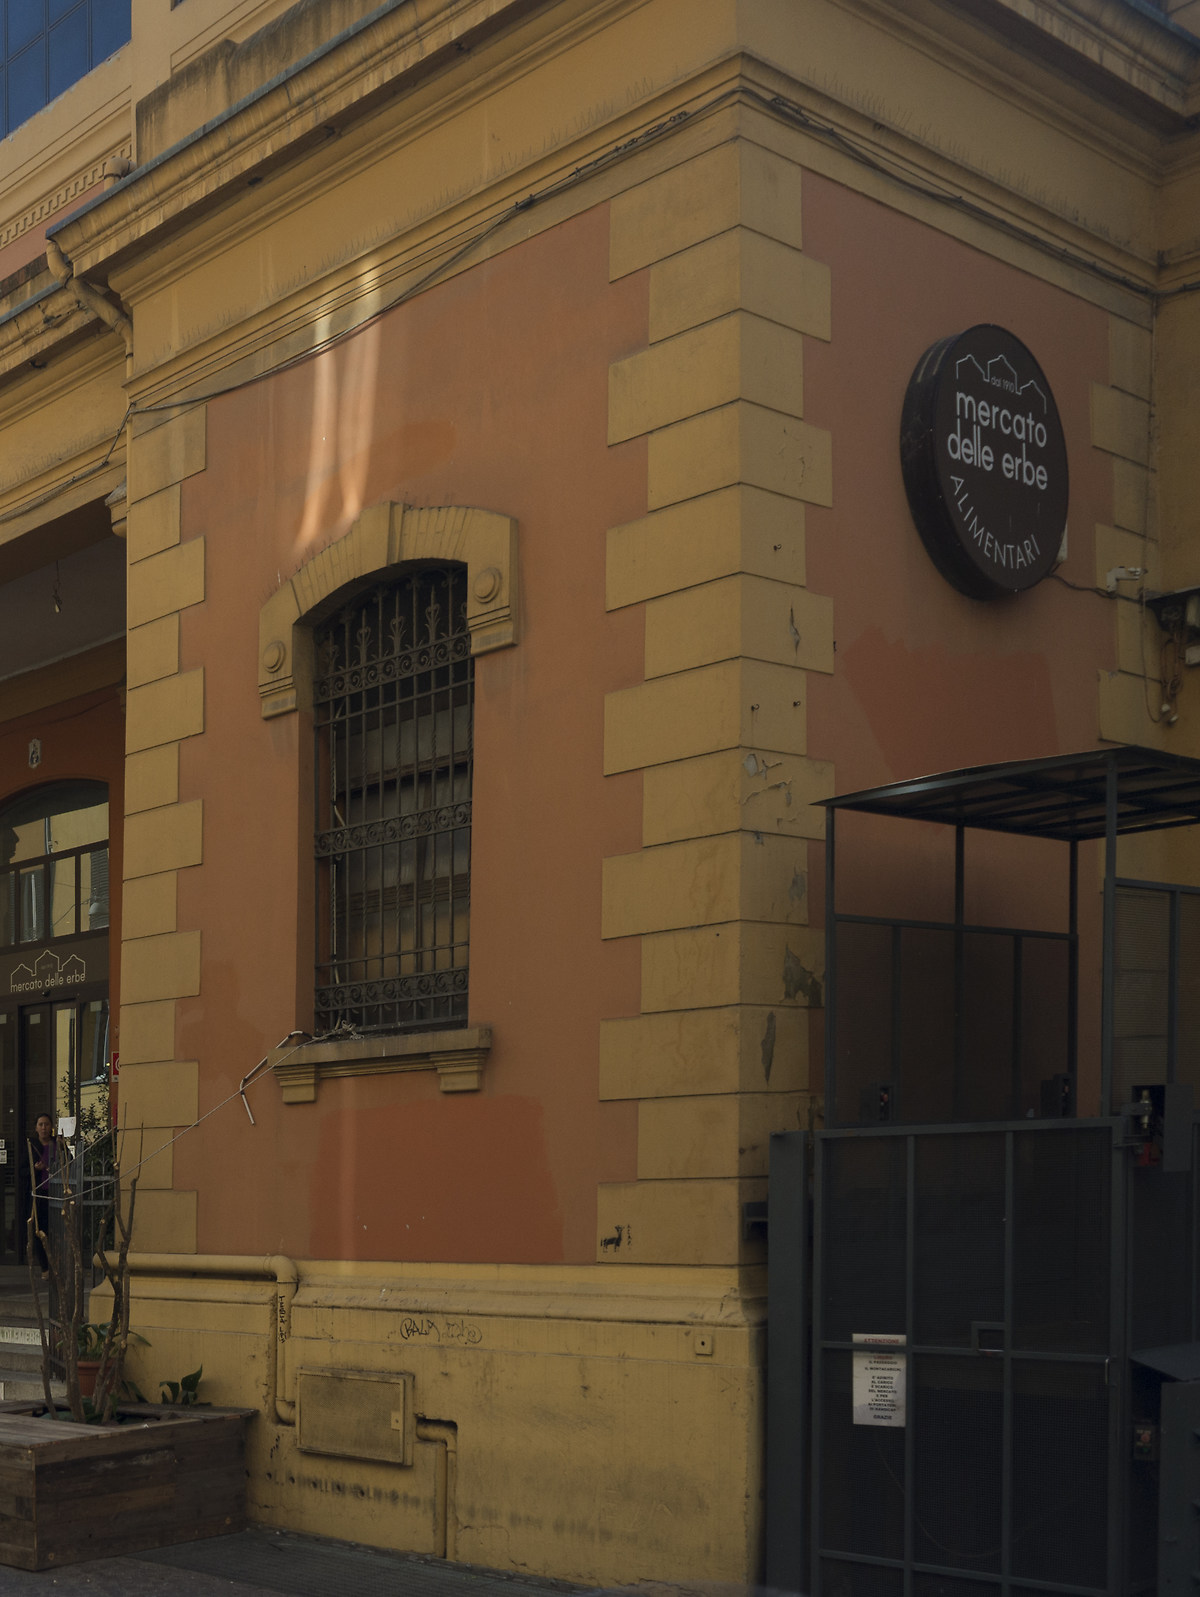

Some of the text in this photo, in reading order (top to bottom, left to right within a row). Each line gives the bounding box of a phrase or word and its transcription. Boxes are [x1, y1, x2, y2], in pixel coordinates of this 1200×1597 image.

[956, 392, 1047, 447] mercato
[947, 417, 1048, 490] delle erbe
[950, 475, 1041, 569] ALIMENTARI
[10, 969, 86, 993] mercato delle erbe
